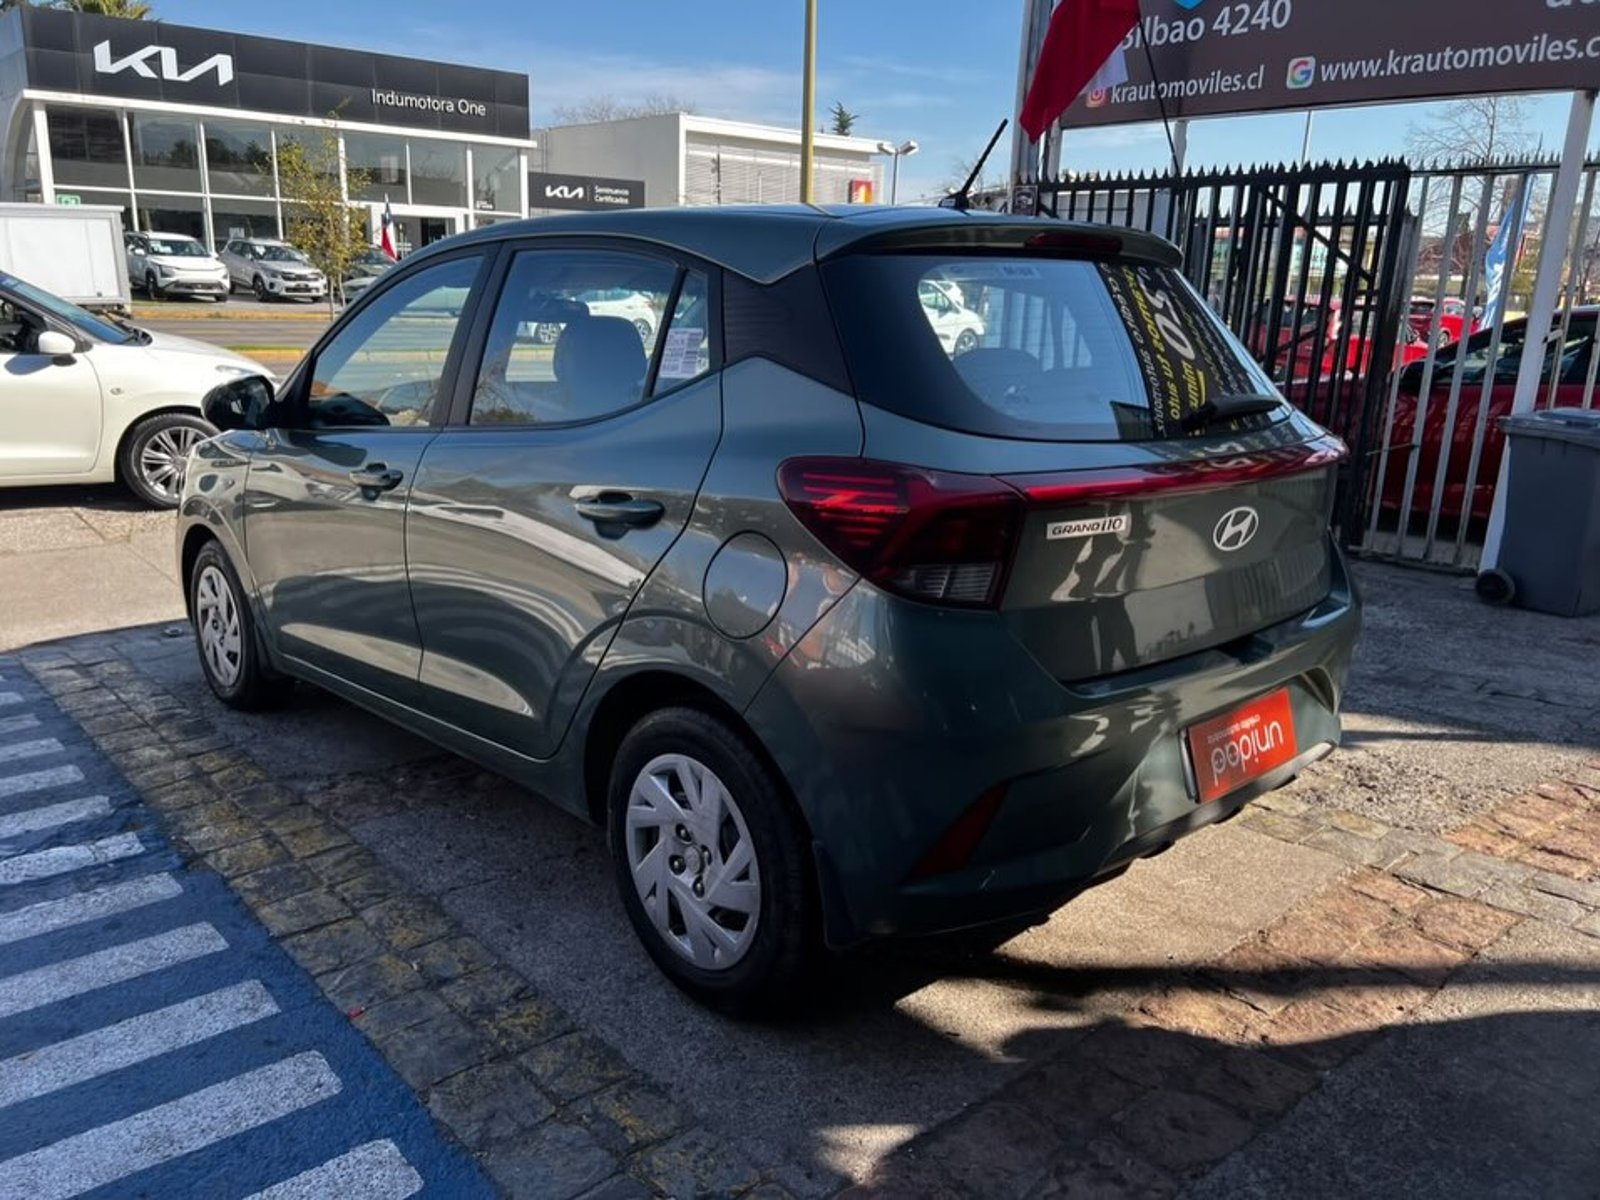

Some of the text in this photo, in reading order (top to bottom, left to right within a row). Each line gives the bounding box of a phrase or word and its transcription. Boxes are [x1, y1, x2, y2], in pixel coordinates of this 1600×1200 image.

[1212, 0, 1292, 36] 4240
[94, 40, 234, 86] KIA
[371, 88, 486, 116] Indumotora One
[1110, 64, 1265, 103] krautomoviles.cl
[545, 184, 585, 199] KIA
[1210, 720, 1284, 788] unidad
